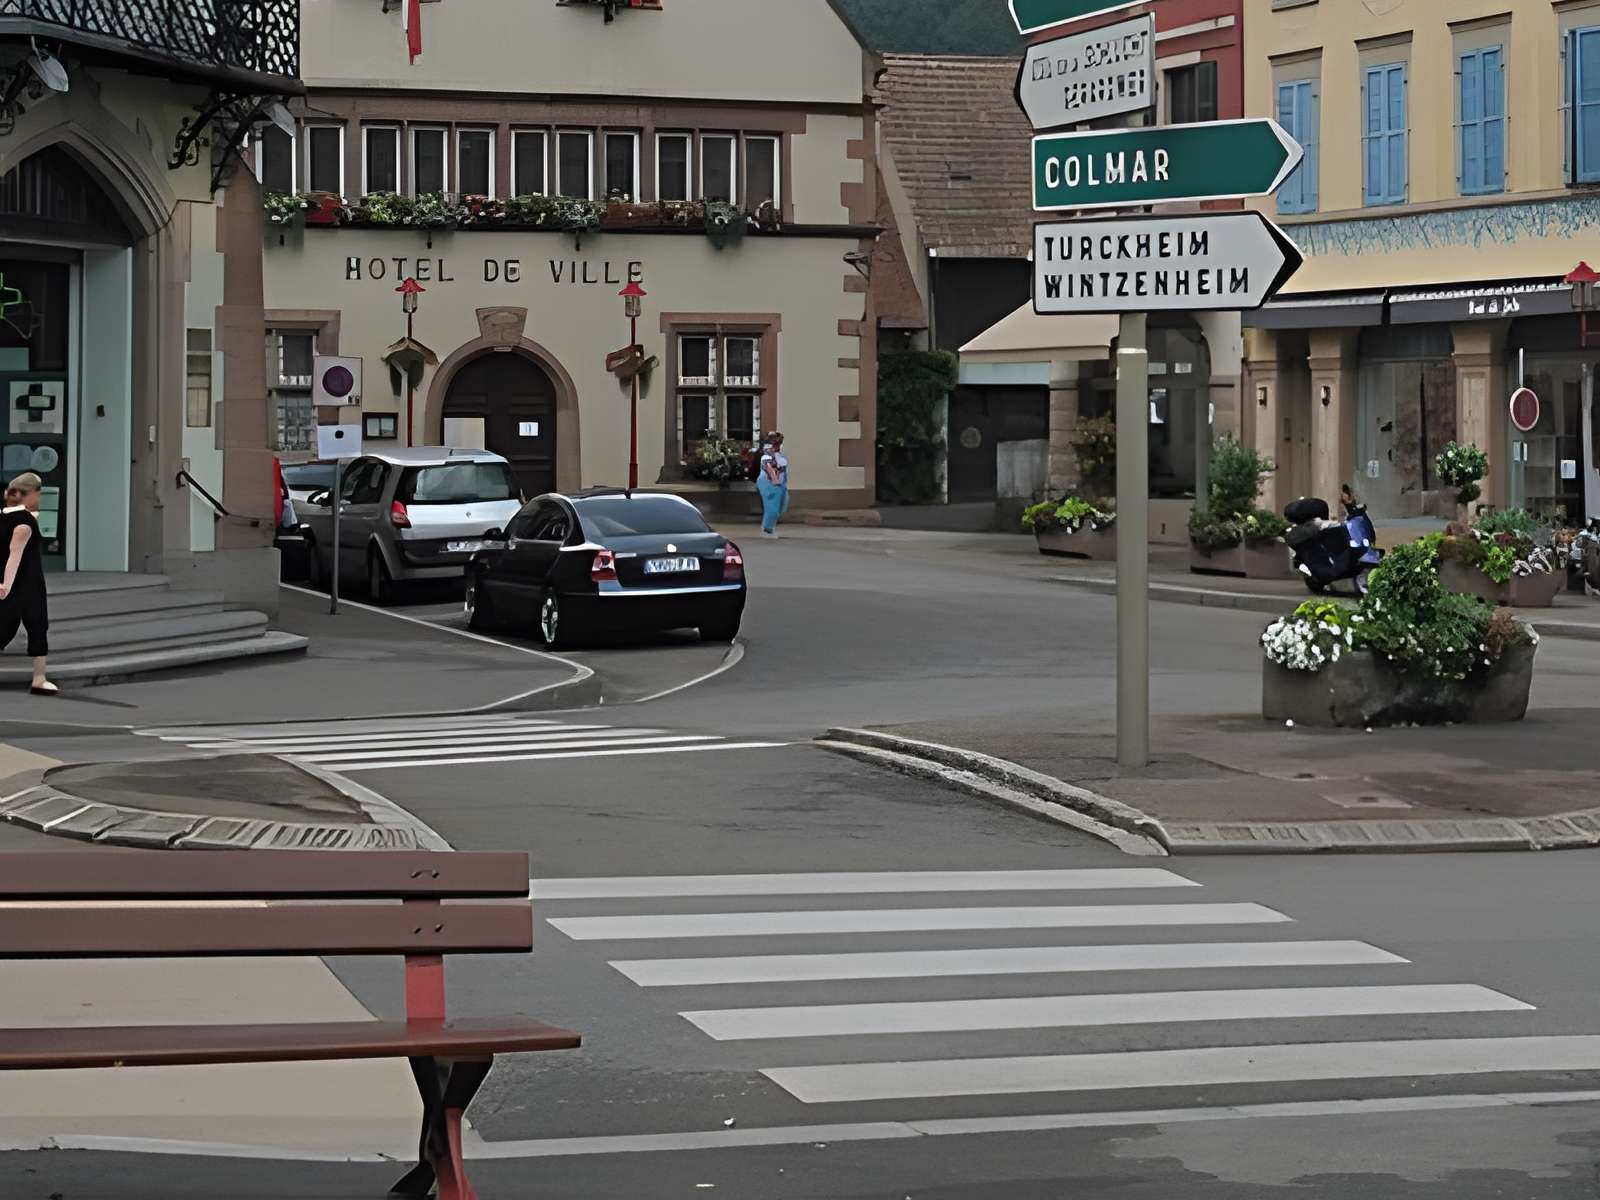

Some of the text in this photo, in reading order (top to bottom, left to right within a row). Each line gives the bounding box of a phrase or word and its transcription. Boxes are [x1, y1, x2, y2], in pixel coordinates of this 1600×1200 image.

[1045, 149, 1169, 188] COLMAR
[1044, 230, 1209, 261] TURCKHEIM
[345, 257, 644, 284] HOTEL DE VILLE
[1044, 267, 1249, 299] WINTZENHEIM
